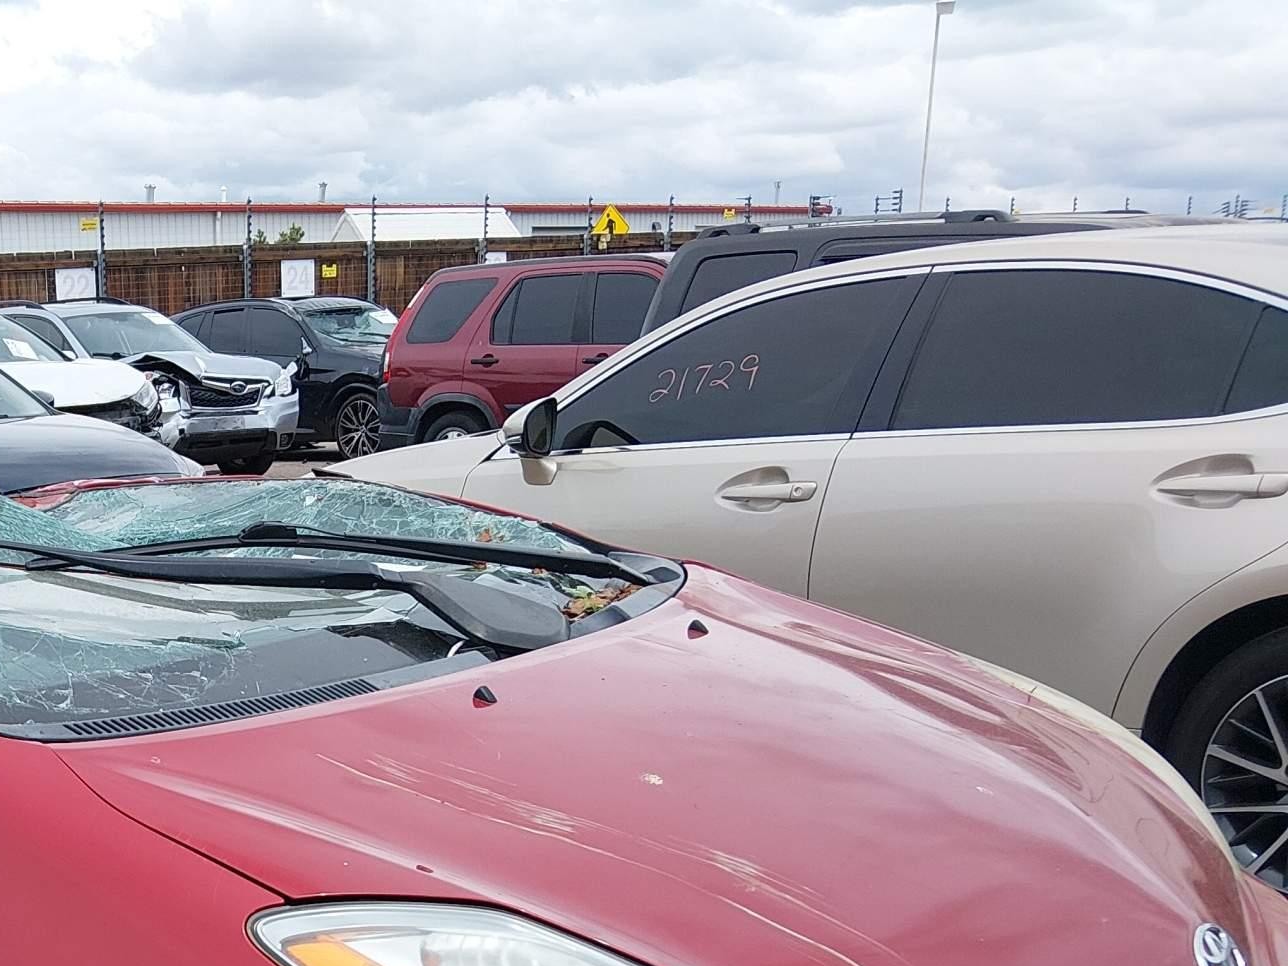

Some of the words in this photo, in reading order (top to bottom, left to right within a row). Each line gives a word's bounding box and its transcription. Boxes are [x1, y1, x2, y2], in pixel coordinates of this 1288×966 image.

[62, 273, 90, 298] 22
[287, 265, 310, 300] 24
[649, 353, 761, 404] 21729
